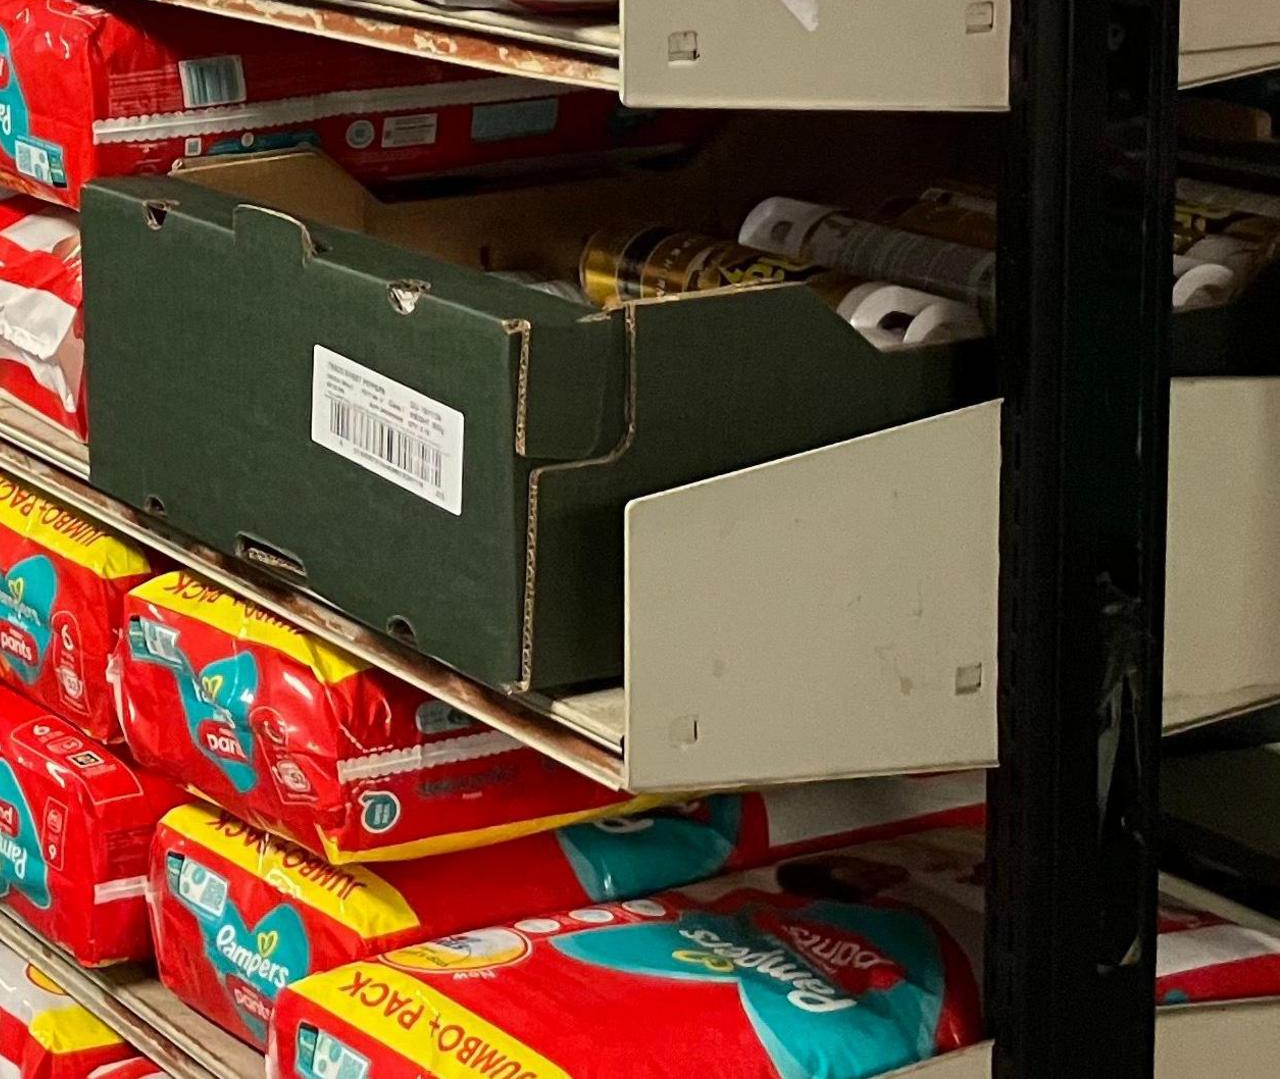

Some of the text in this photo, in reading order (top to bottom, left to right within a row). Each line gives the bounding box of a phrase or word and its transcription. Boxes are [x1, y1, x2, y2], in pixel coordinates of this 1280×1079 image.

[0, 631, 33, 661] pants
[61, 624, 74, 650] 6
[206, 732, 246, 758] pan
[216, 924, 290, 989] Pampers
[783, 925, 893, 968] pants
[678, 927, 859, 1013] Pampers
[339, 971, 425, 1031] PACK
